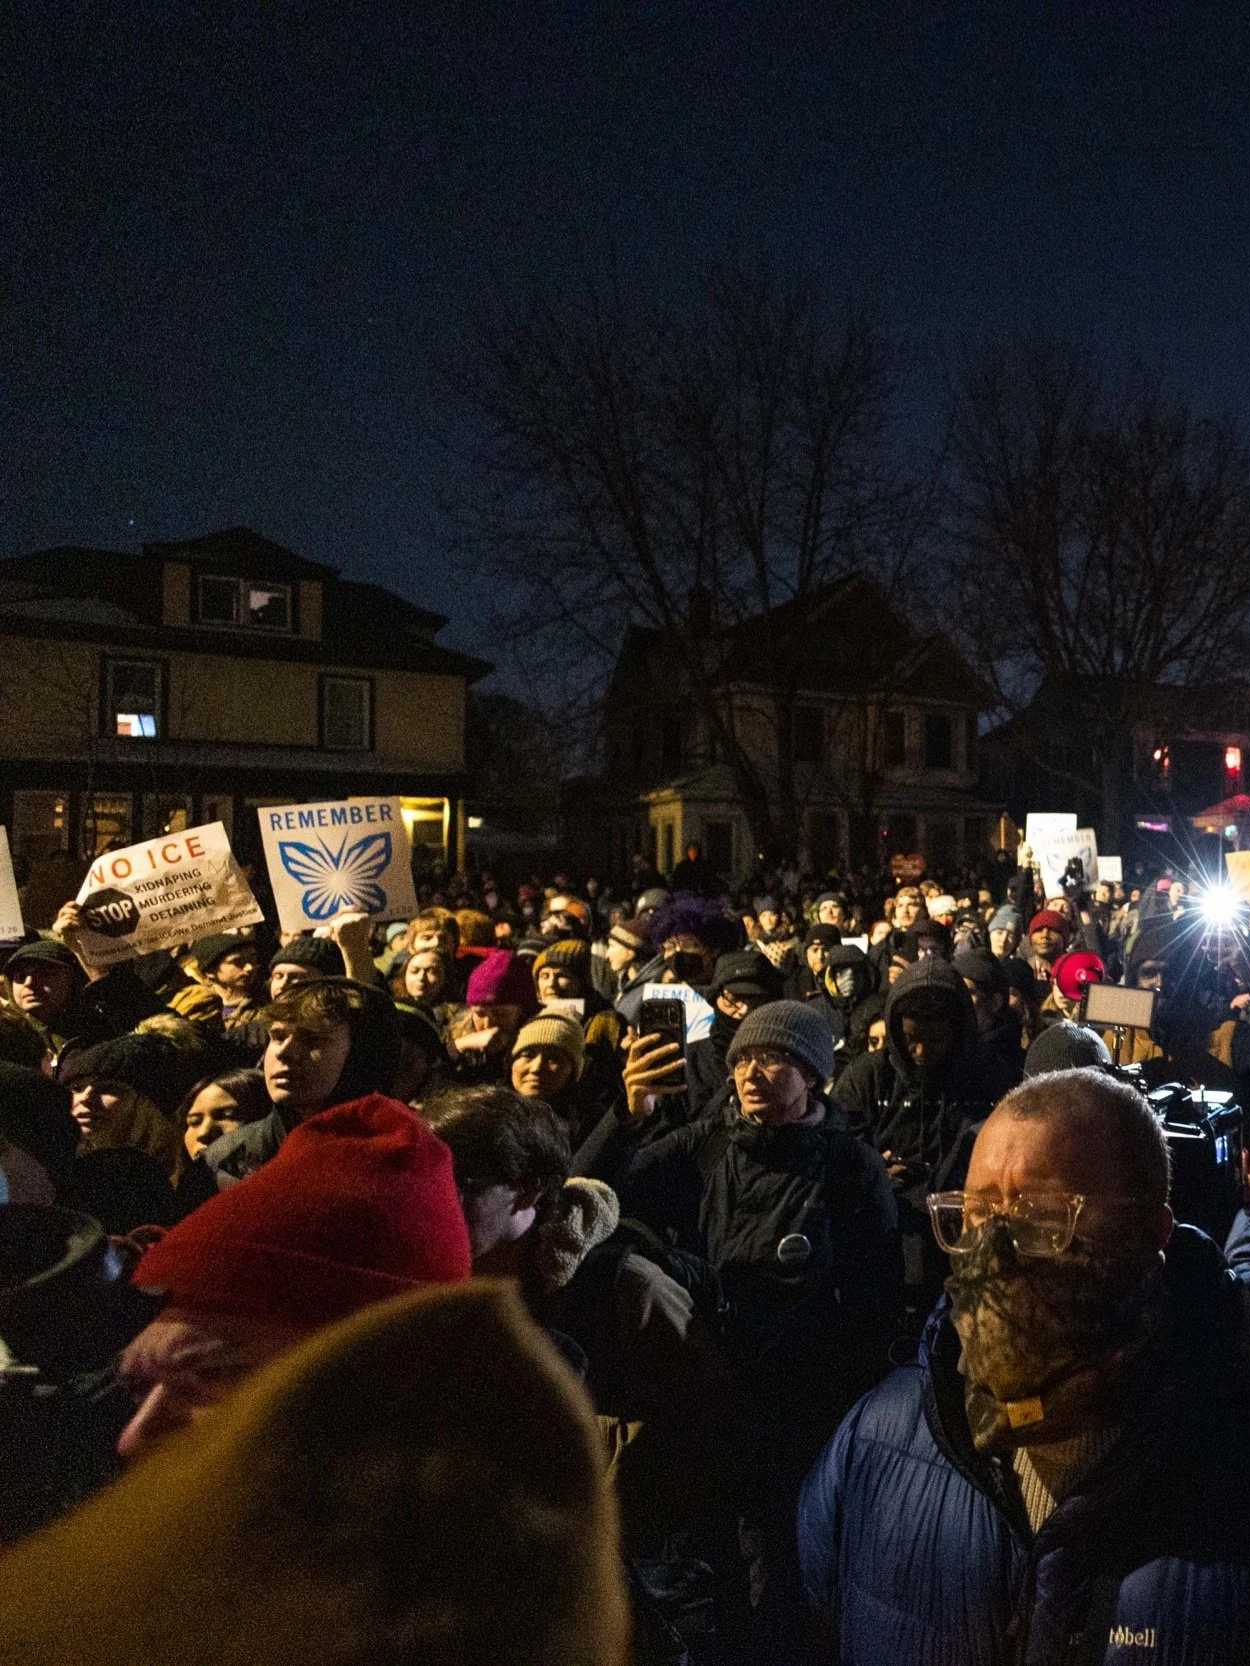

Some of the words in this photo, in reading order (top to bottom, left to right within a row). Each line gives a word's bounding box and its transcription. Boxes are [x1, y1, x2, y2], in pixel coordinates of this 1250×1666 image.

[270, 803, 393, 831] REMEMBER
[89, 858, 131, 886] NO
[147, 836, 205, 869] ICE
[135, 868, 201, 892] KIDNAPING
[139, 882, 211, 908] MURDERING
[86, 900, 132, 927] STOP
[149, 897, 215, 922] DETAINING
